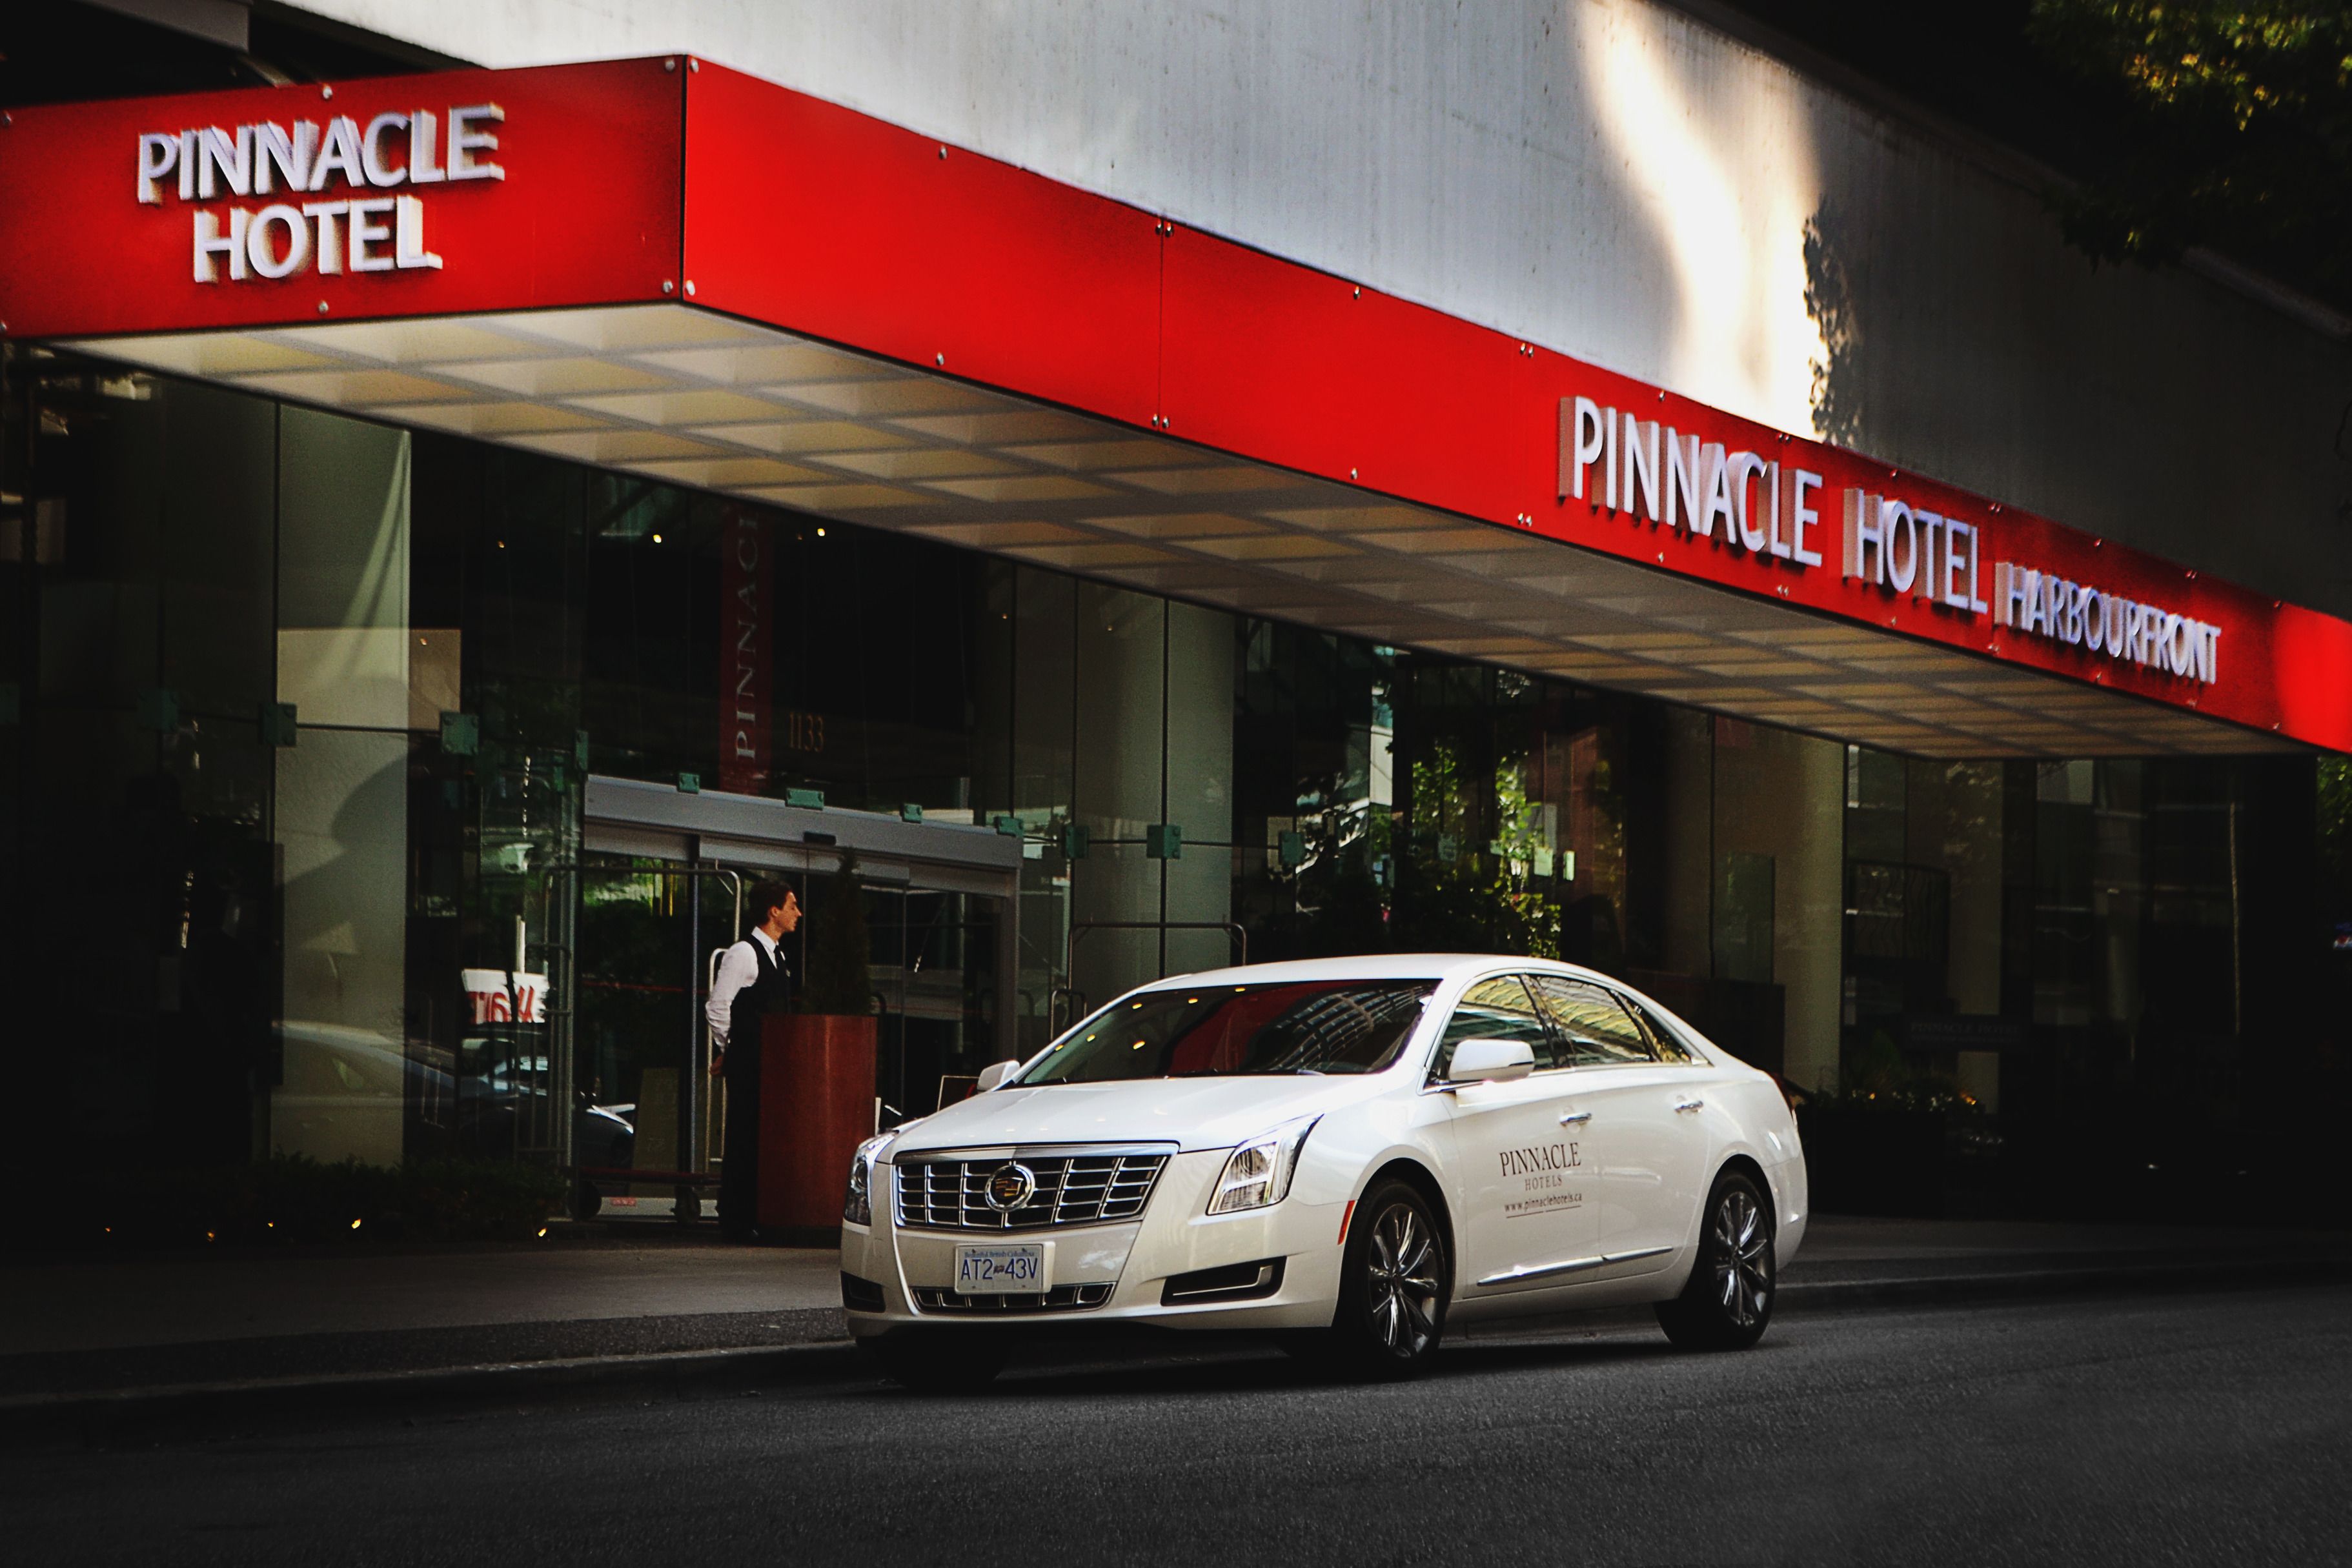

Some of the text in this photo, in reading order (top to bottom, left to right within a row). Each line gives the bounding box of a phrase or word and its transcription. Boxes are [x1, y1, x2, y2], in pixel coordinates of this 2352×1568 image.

[137, 102, 505, 204] PINNACLE
[194, 194, 443, 283] HOTEL
[1557, 395, 2222, 684] PINNACLE HOTEL HARBOURFRONT
[736, 510, 759, 760] PINNACL
[789, 710, 825, 752] 1133
[1499, 1142, 1581, 1176] PINNACLE
[1525, 1175, 1563, 1191] HOTELS
